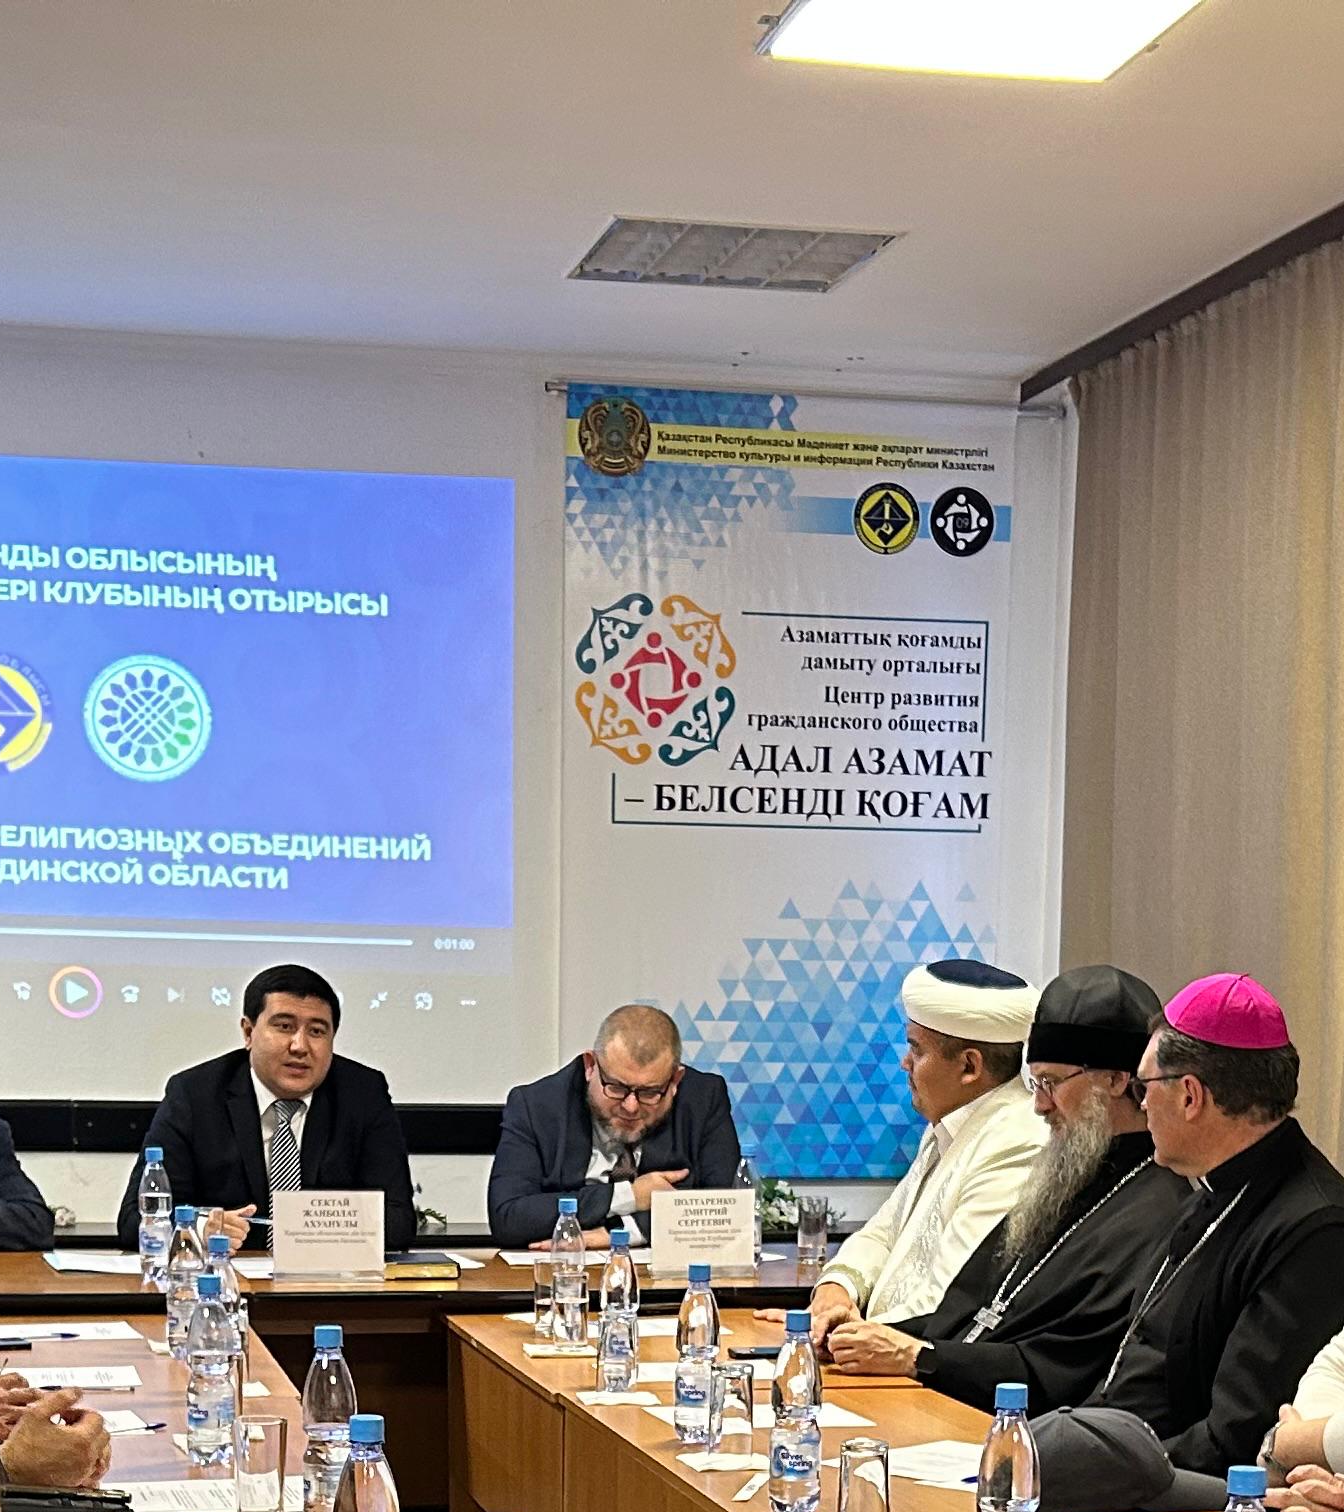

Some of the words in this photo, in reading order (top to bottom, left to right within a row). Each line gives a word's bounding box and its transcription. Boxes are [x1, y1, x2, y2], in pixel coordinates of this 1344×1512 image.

[656, 430, 712, 443] Қазақстан
[714, 433, 794, 448] Республикасы
[796, 438, 849, 451] Мәдениет
[851, 442, 879, 453] және
[881, 444, 924, 456] ақпарат
[657, 445, 736, 460] Министерство
[739, 450, 791, 464] культуры
[793, 454, 801, 463] и
[803, 453, 873, 467] информации
[875, 456, 939, 470] Республики
[941, 459, 995, 472] Казахстан
[65, 546, 278, 582] ОБЛЫСЫНЫҢ
[43, 579, 225, 614] КЛУБЫНЫҢ
[228, 587, 389, 617] ОТЫРЫСЫ
[780, 625, 892, 650] Азаматтық
[897, 633, 982, 652] қоғамды
[801, 653, 878, 675] дамыту
[883, 658, 981, 676] орталығы
[824, 685, 885, 709] Центр
[890, 691, 980, 710] развития
[747, 712, 882, 732] гражданского
[888, 713, 979, 735] общества
[728, 744, 832, 777] АДАЛ
[842, 747, 993, 779] АЗАМАТ
[653, 783, 844, 821] БЕЛСЕНДІ
[856, 790, 990, 823] ҚОҒАМ
[208, 832, 432, 862] ОБЪЕДИНЕНИЙ
[148, 863, 289, 890] ОБЛАСТИ
